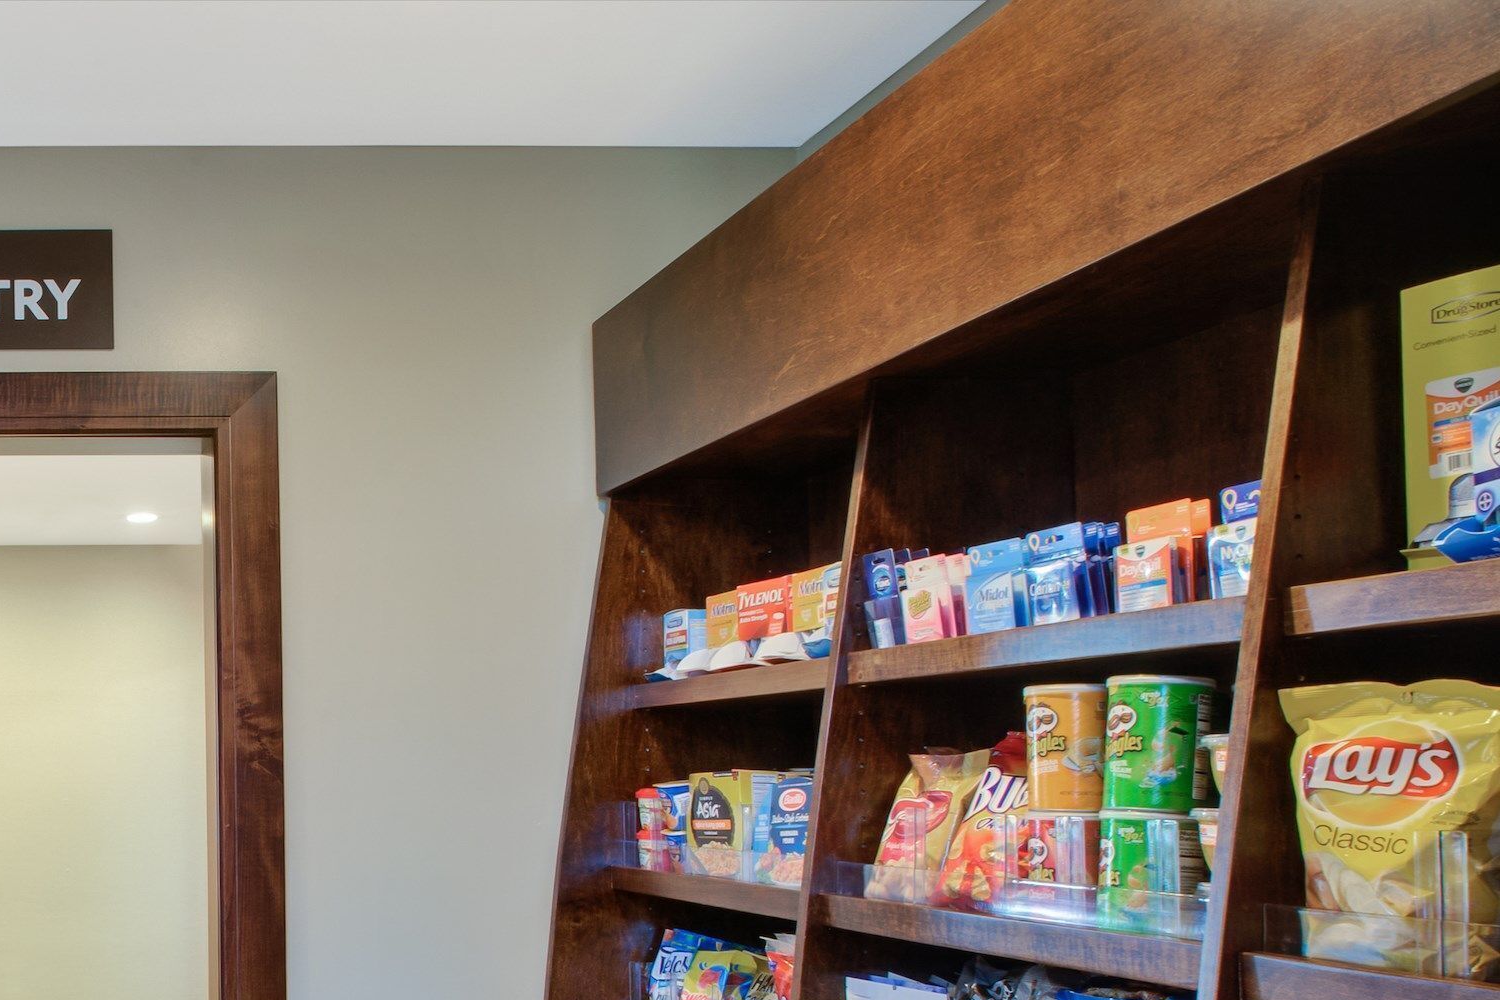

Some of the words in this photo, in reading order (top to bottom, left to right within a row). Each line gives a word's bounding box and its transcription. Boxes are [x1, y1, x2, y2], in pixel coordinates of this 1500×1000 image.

[738, 588, 785, 610] TYLENOL
[1309, 740, 1450, 795] Lay's
[1333, 824, 1429, 855] Classic
